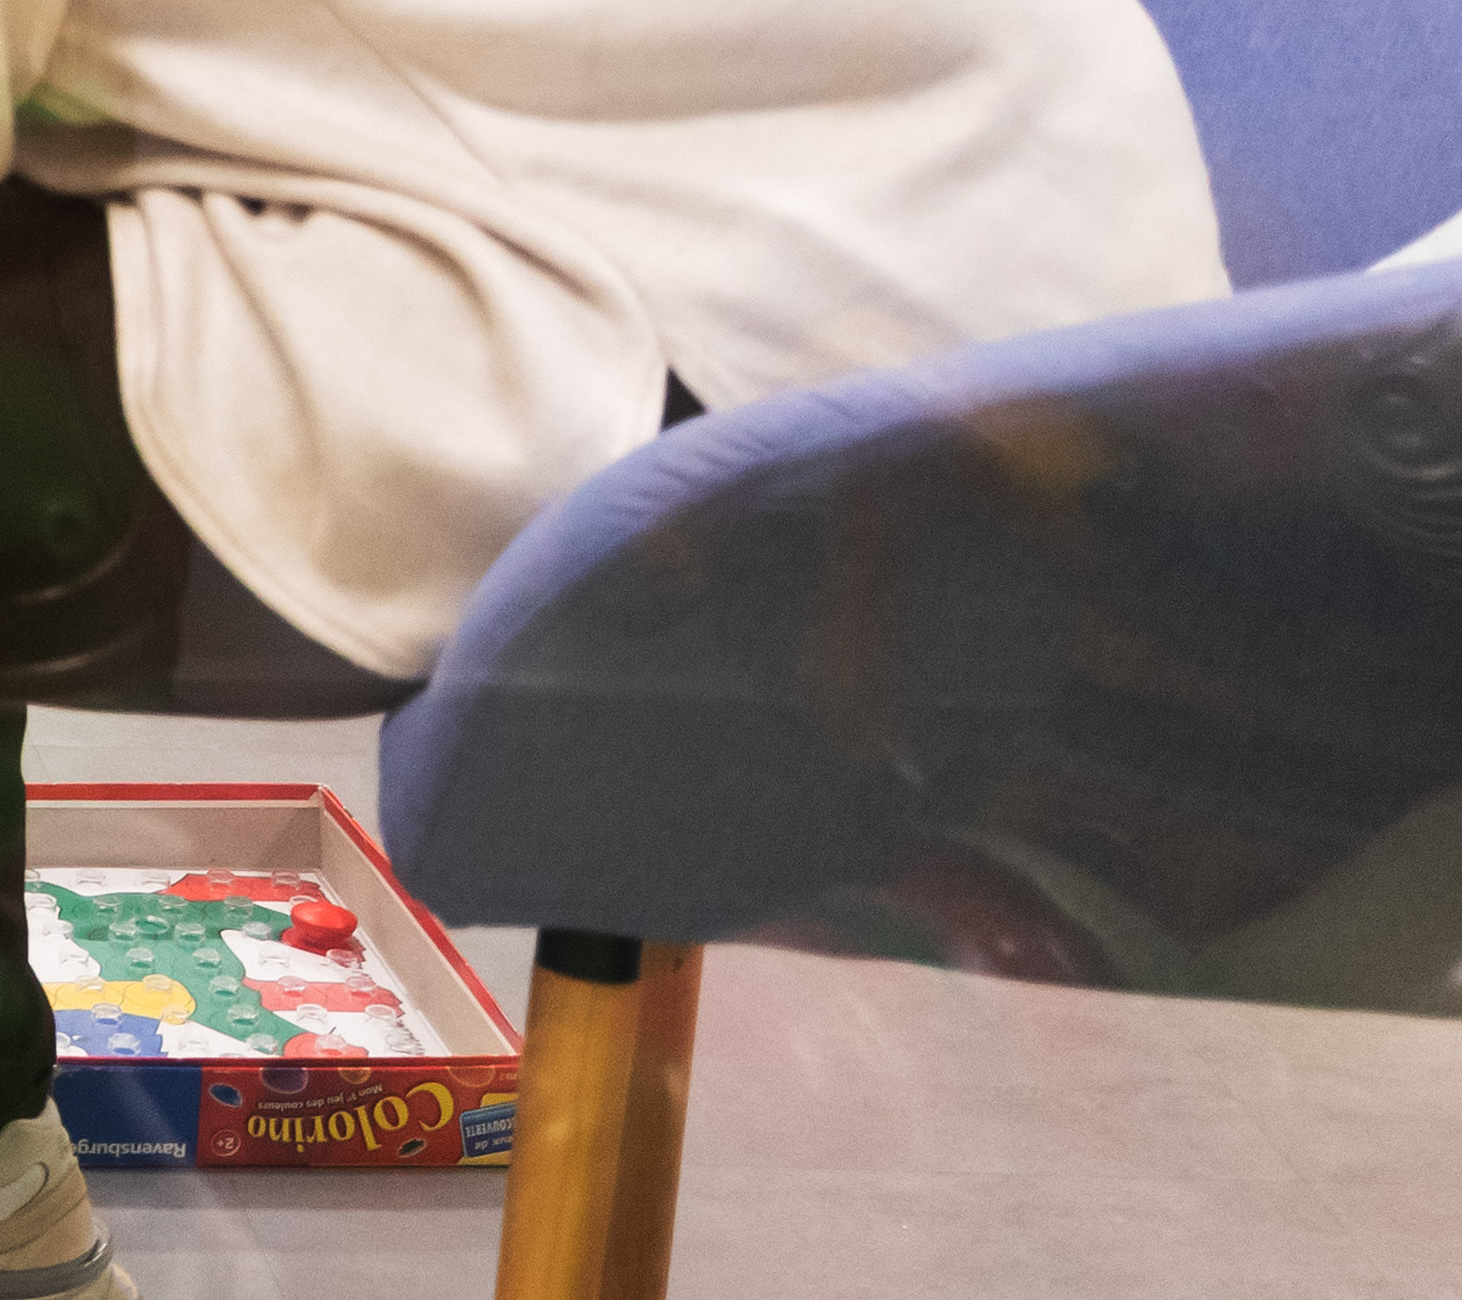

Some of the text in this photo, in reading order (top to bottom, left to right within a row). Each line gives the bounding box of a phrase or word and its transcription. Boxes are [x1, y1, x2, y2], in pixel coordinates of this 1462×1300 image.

[358, 1084, 383, 1097] Mon
[258, 1101, 304, 1112] couleurs
[306, 1099, 324, 1108] des
[247, 1082, 454, 1153] Colorino
[465, 1117, 515, 1138] COUVERTE
[475, 1140, 489, 1151] de
